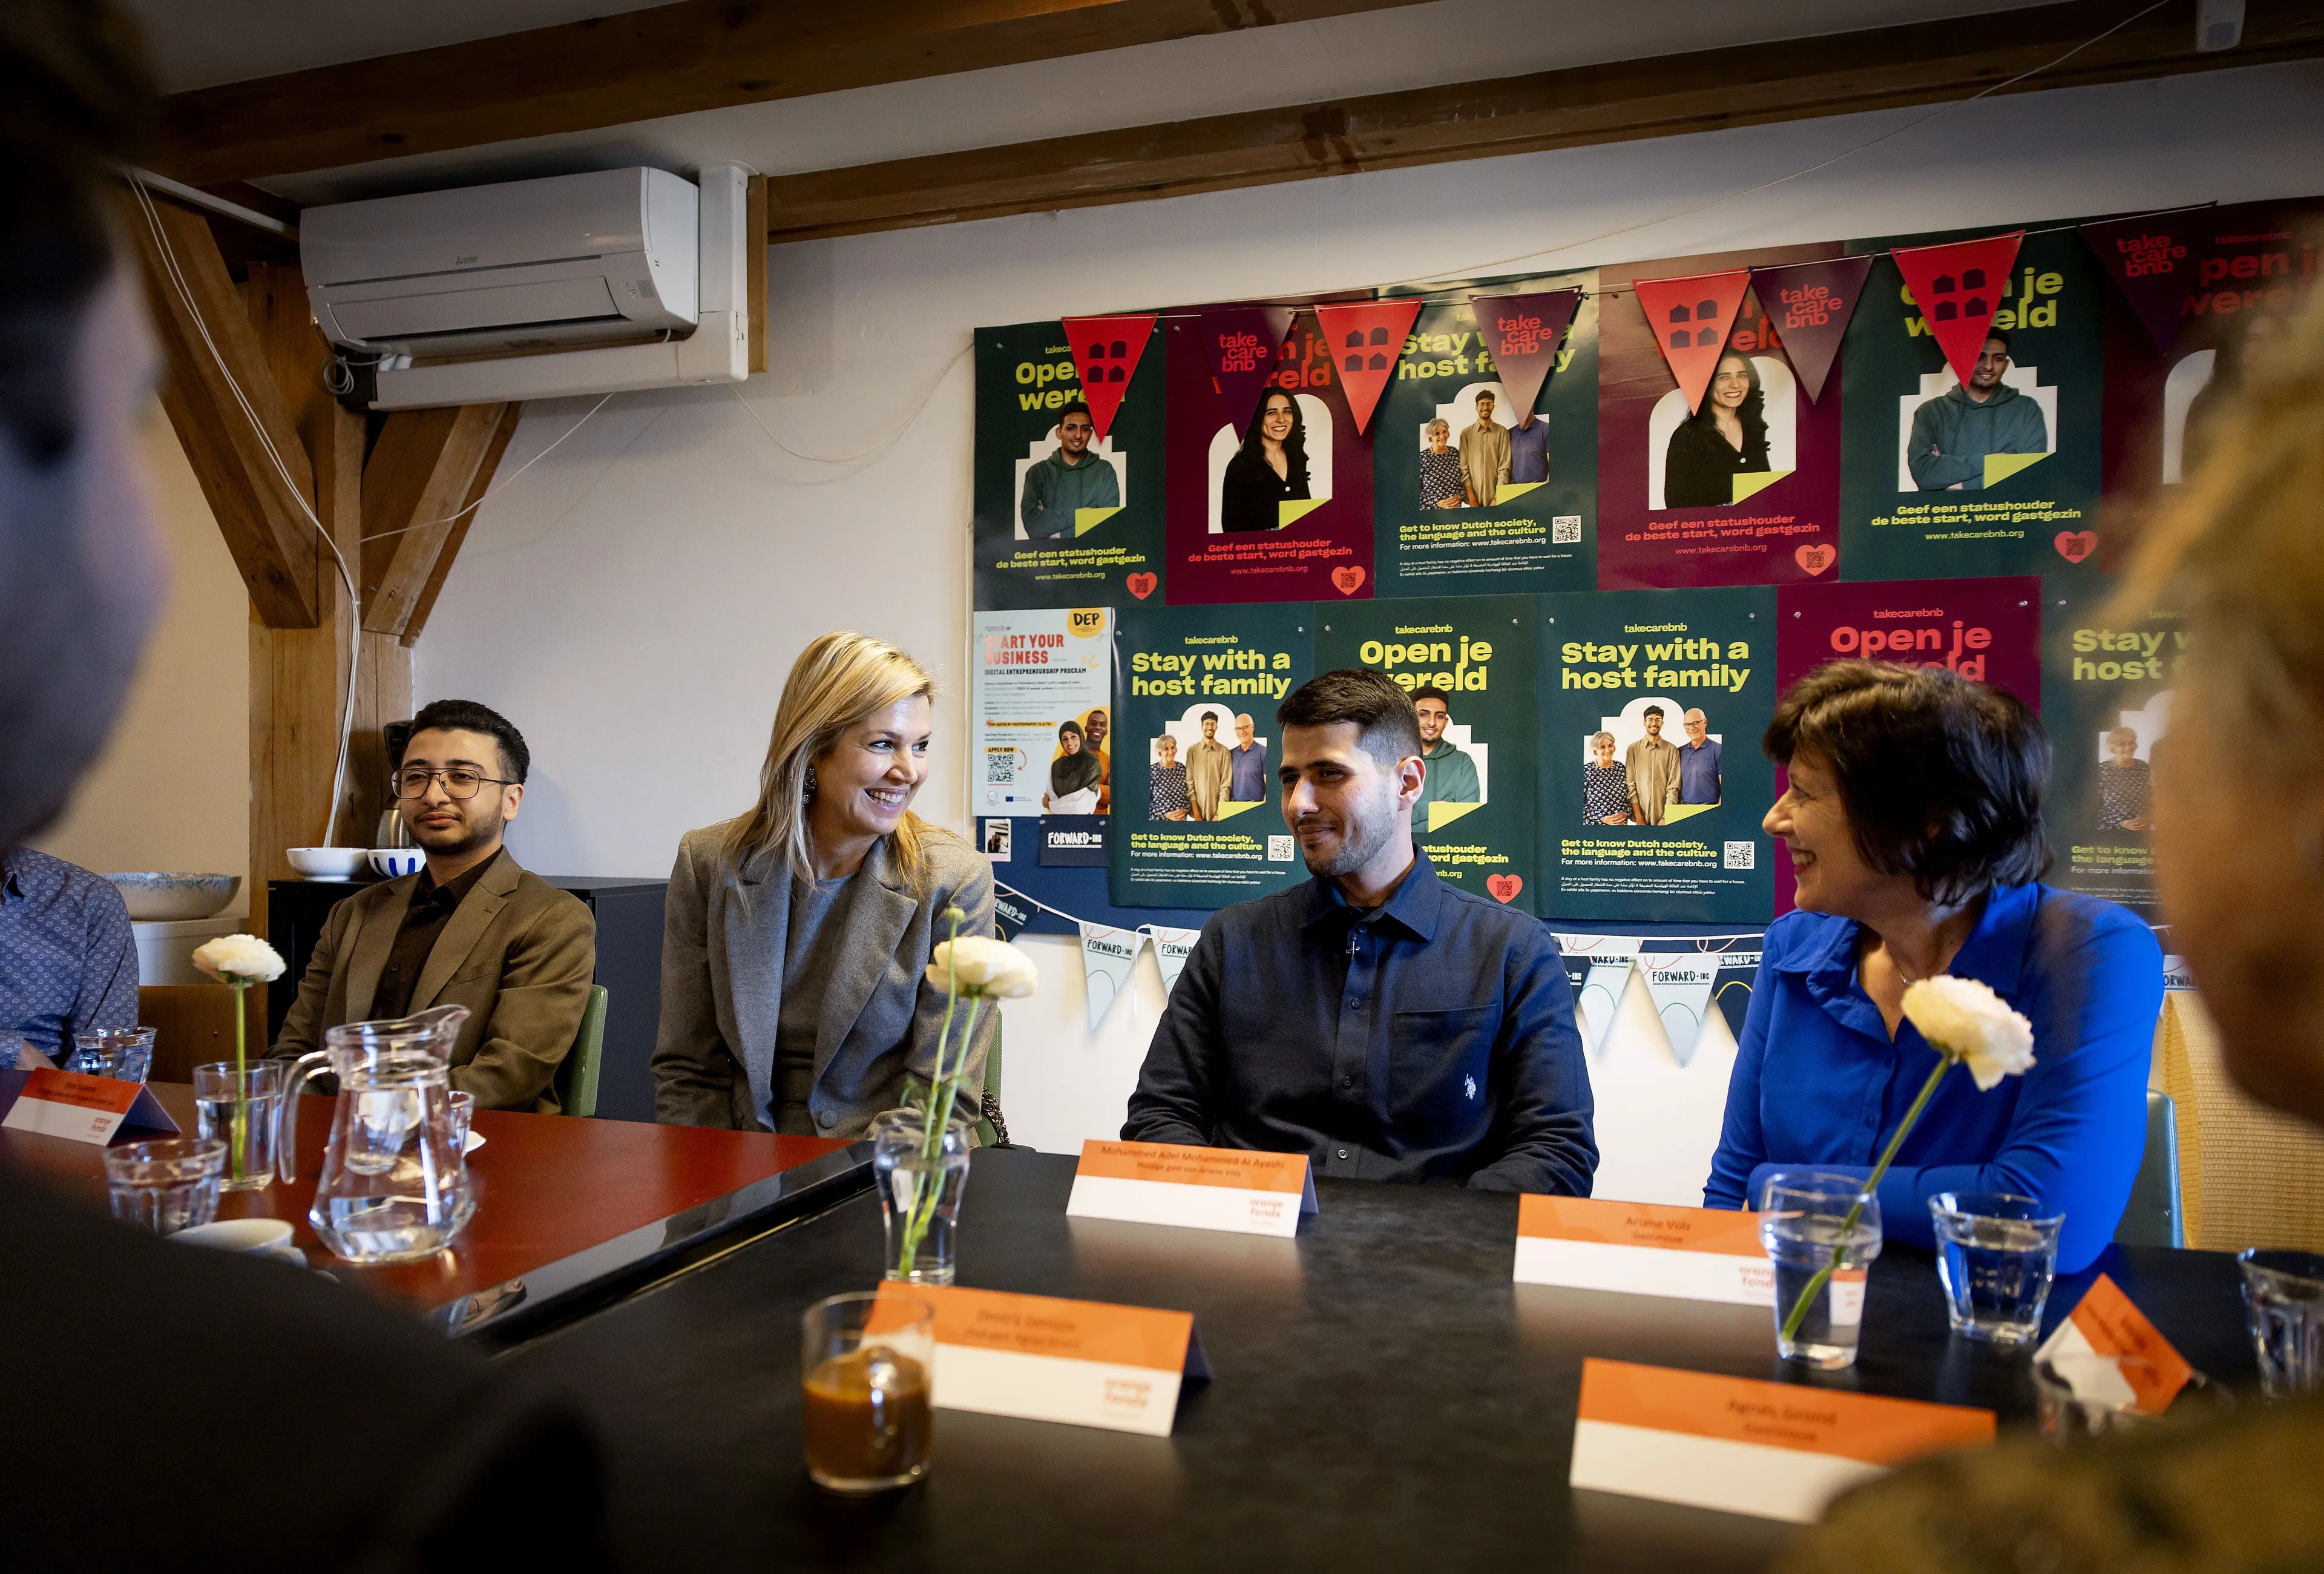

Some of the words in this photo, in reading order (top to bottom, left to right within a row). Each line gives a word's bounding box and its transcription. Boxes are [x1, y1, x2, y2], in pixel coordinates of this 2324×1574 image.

[2116, 234, 2171, 253] take
[2131, 246, 2187, 263] care
[2125, 260, 2174, 277] bnb
[2201, 252, 2289, 288] pen
[2020, 267, 2064, 303] je
[1781, 284, 1830, 303] take
[1792, 298, 1843, 314] care
[1497, 314, 1541, 332] take
[1785, 311, 1829, 329] bnb
[1219, 331, 1257, 348] take
[1508, 328, 1552, 343] care
[1227, 345, 1268, 360] care
[1302, 333, 1331, 363] je
[1501, 340, 1539, 355] bnb
[1222, 357, 1256, 372] bnb
[1399, 355, 1469, 380] host
[1016, 361, 1080, 387] Ope
[1897, 505, 1929, 515] Geef
[1960, 500, 2055, 512] statushouder
[1649, 520, 1680, 531] Geef
[1681, 521, 1704, 529] een
[1707, 515, 1795, 528] statushouder
[1871, 516, 1889, 525] de
[1891, 515, 1931, 525] beste
[1933, 513, 1972, 524] start,
[1975, 512, 2009, 522] word
[2012, 509, 2081, 523] gastgezin
[1399, 525, 1417, 533] Get
[1433, 522, 1460, 532] know
[1462, 520, 1492, 530] Dutch
[1494, 518, 1537, 529] society,
[1625, 533, 1641, 541] de
[1644, 530, 1679, 541] beste
[1682, 529, 1718, 539] start,
[1721, 525, 1753, 537] word
[1756, 523, 1820, 537] gastgezin
[1399, 533, 1417, 541] the
[1419, 531, 1465, 542] language
[1467, 529, 1486, 538] and
[1488, 528, 1506, 536] the
[1508, 525, 1546, 535] culture
[1926, 530, 2024, 540] www.takecarebnb.org
[1209, 544, 1233, 552] Geef
[1258, 539, 1331, 550] statushouder
[1472, 537, 1546, 547] www.takecarebnb.org
[1676, 544, 1767, 555] www.takecarebnb.org
[1014, 551, 1037, 559] Geef
[1059, 547, 1126, 558] statushouder
[1204, 553, 1234, 561] beste
[1236, 551, 1267, 560] start,
[1269, 549, 1296, 558] word
[1298, 547, 1352, 559] gastgezin
[1010, 559, 1038, 568] beste
[1040, 558, 1068, 567] start,
[1070, 556, 1094, 565] word
[1096, 554, 1145, 566] gastgezin
[1035, 572, 1105, 581] www.takecarebnb.org
[1231, 565, 1308, 575] www.takecarebnb.org
[1073, 613, 1100, 626] DEP
[1873, 607, 1944, 618] takecarebnb
[1394, 624, 1452, 634] takecarebnb
[1624, 622, 1687, 633] takecarebnb
[985, 635, 1026, 649] START
[1029, 634, 1065, 648] YOUR
[1184, 636, 1238, 645] takecarebnb
[1831, 626, 1942, 657] Open
[1948, 621, 1992, 657] je
[2072, 628, 2166, 657] Stay
[985, 650, 1048, 665] BUSINESS
[1360, 640, 1451, 669] Open
[1456, 636, 1492, 668] je
[1561, 642, 1639, 668] Stay
[1644, 637, 1720, 661] with
[1728, 641, 1749, 659] a
[1132, 652, 1197, 676] Stay
[1202, 648, 1265, 670] with
[1272, 653, 1290, 669] a
[2073, 657, 2163, 680] host
[1387, 666, 1487, 692] ereld
[1562, 667, 1636, 690] host
[1643, 664, 1751, 693] family
[1132, 676, 1195, 696] host
[1201, 673, 1292, 700] family
[1147, 841, 1190, 851] language
[1160, 833, 1185, 841] know
[1215, 834, 1254, 844] society,
[1561, 839, 1581, 848] Get
[1596, 840, 1626, 848] know
[1661, 840, 1707, 851] society,
[1422, 845, 1487, 853] atushouder
[1581, 848, 1631, 858] language
[1632, 848, 1653, 857] and
[1676, 849, 1718, 858] culture
[1452, 854, 1509, 864] gastgezin
[1638, 860, 1718, 869] www.takecarebnb.org
[2096, 855, 2153, 866] language
[1250, 1198, 1284, 1211] oranje
[1250, 1208, 1281, 1218] fonds
